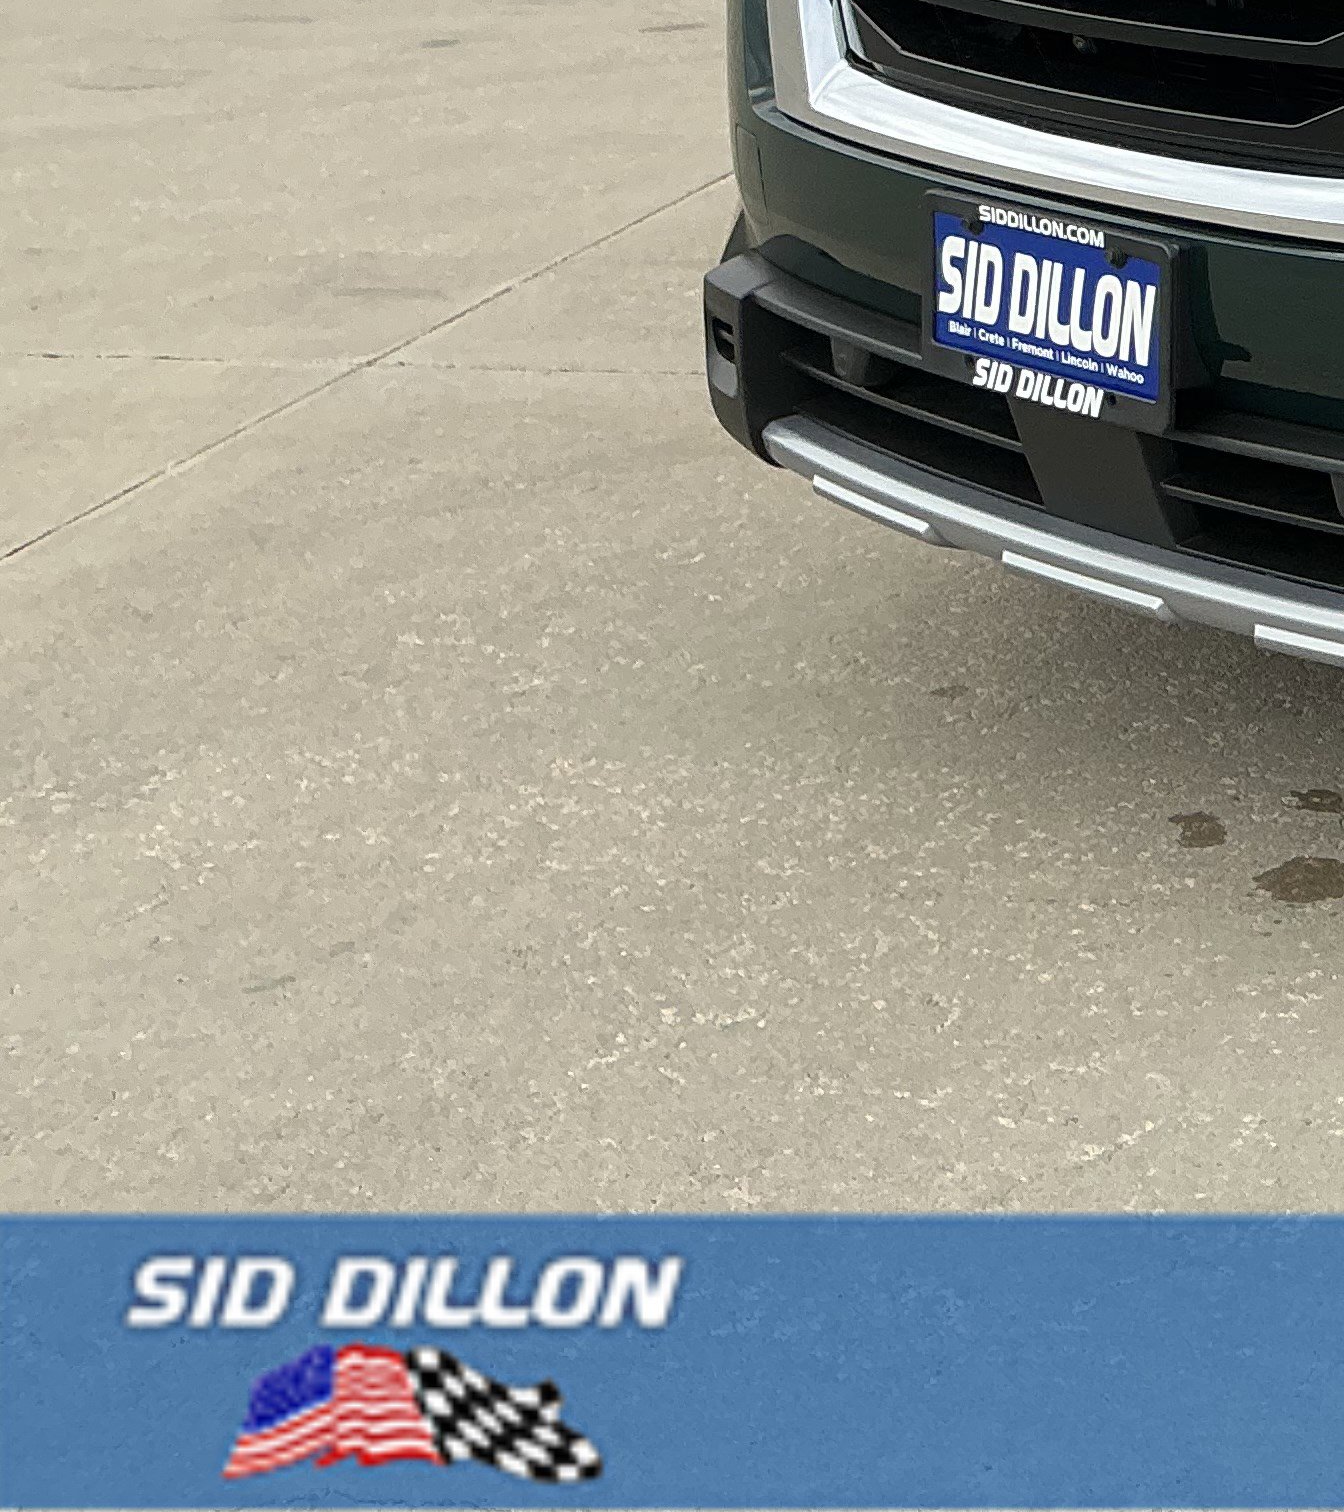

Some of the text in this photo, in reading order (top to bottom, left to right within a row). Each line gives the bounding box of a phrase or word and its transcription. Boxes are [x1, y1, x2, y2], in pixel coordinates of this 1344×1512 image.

[978, 204, 1105, 249] SIDDILLON.COM
[937, 235, 1157, 367] SID DILLON
[948, 320, 1145, 385] Blair Crete Fremont Lincoln Wahoo
[972, 358, 1105, 418] SID DILLON
